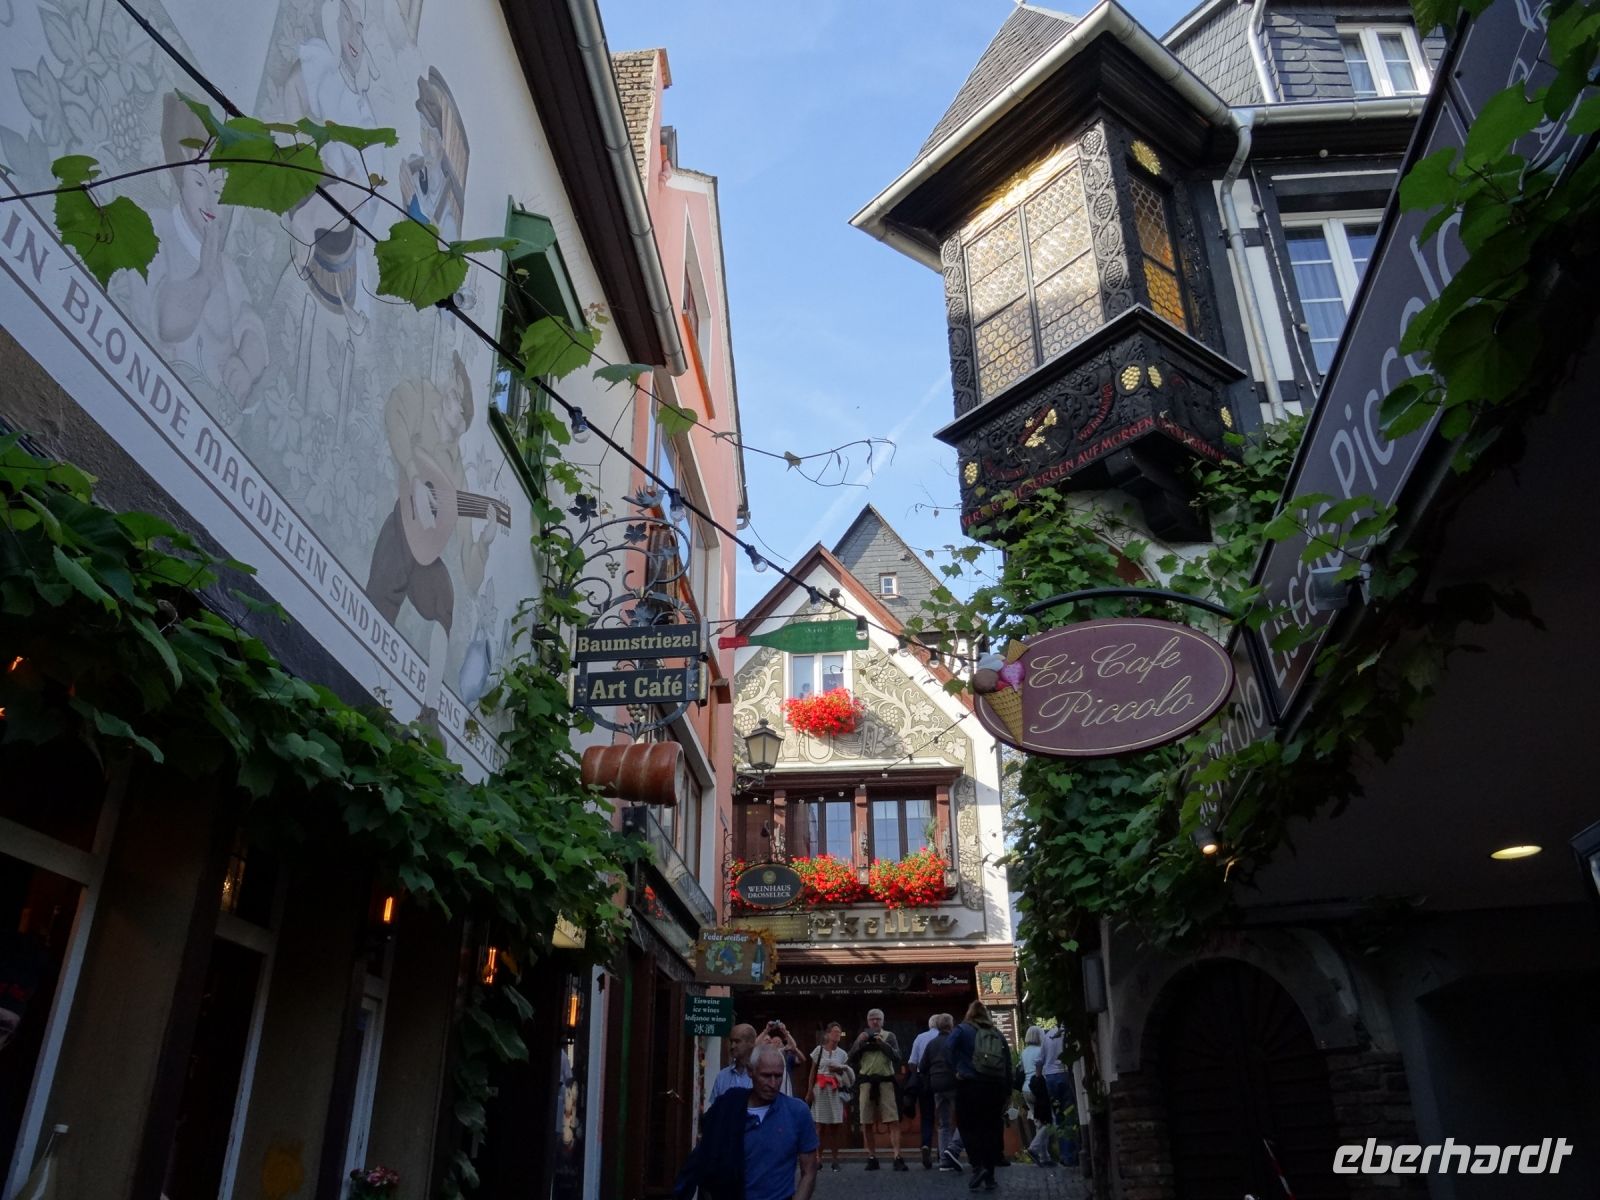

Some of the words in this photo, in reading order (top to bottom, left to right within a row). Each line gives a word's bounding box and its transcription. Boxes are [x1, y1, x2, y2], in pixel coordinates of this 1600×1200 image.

[1077, 443, 1100, 465] AUF
[1101, 415, 1154, 453] MORGEN
[62, 275, 191, 439] BLONDE
[195, 427, 329, 586] MAGDELEIN
[329, 574, 370, 632] SIND
[371, 622, 400, 665] DES
[577, 630, 698, 653] Baumstriezel
[590, 679, 627, 700] Art
[634, 673, 683, 698] Café
[1029, 652, 1085, 689] Eis
[1029, 675, 1195, 735] Piccolo
[747, 884, 791, 892] WEINHAUS
